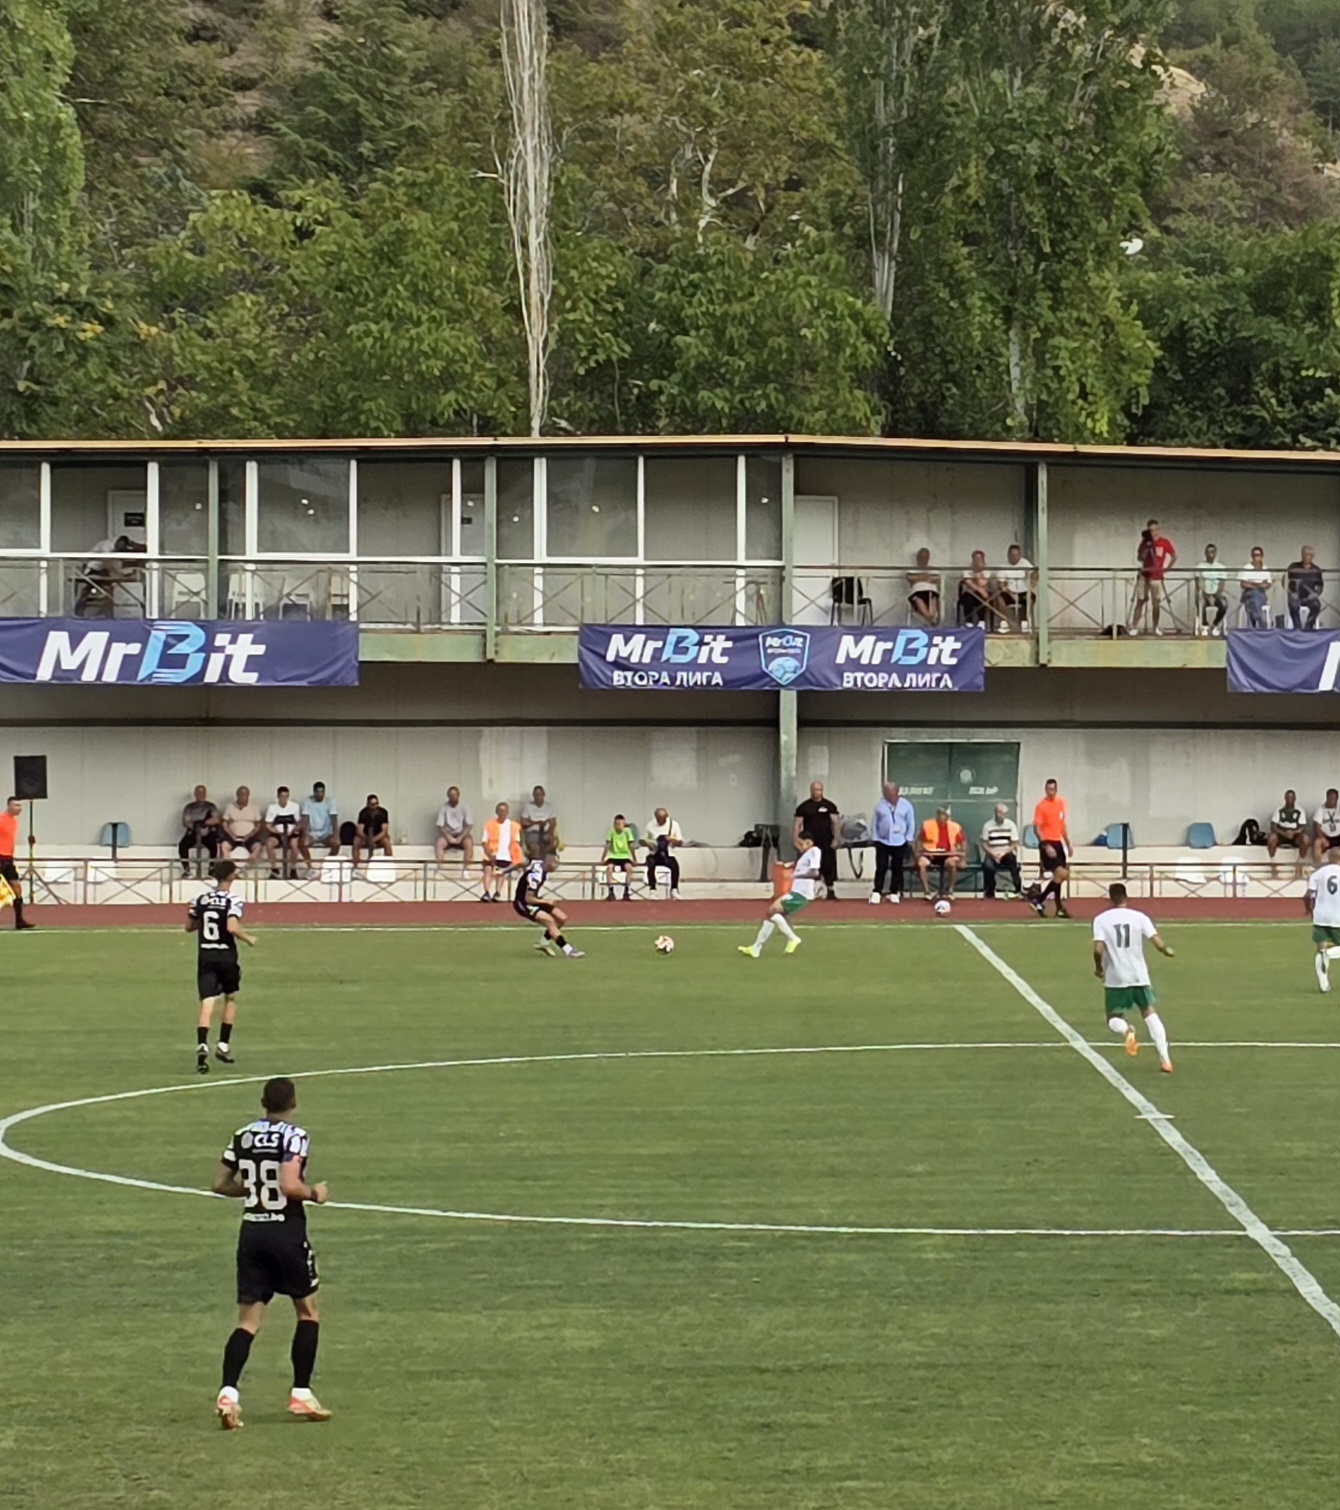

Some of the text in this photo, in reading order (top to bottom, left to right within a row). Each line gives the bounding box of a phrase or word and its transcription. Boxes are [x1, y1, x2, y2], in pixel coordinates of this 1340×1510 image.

[35, 620, 267, 684] MrBit
[605, 627, 734, 664] MrBit
[834, 629, 963, 665] MrBit
[612, 670, 724, 687] ВТОРА ЛИГА
[842, 672, 953, 689] ВТОРА ЛИГА
[1327, 875, 1338, 895] 6
[203, 911, 220, 940] 6
[1113, 923, 1130, 948] 11
[254, 1133, 280, 1148] CLS
[238, 1159, 288, 1210] 38
